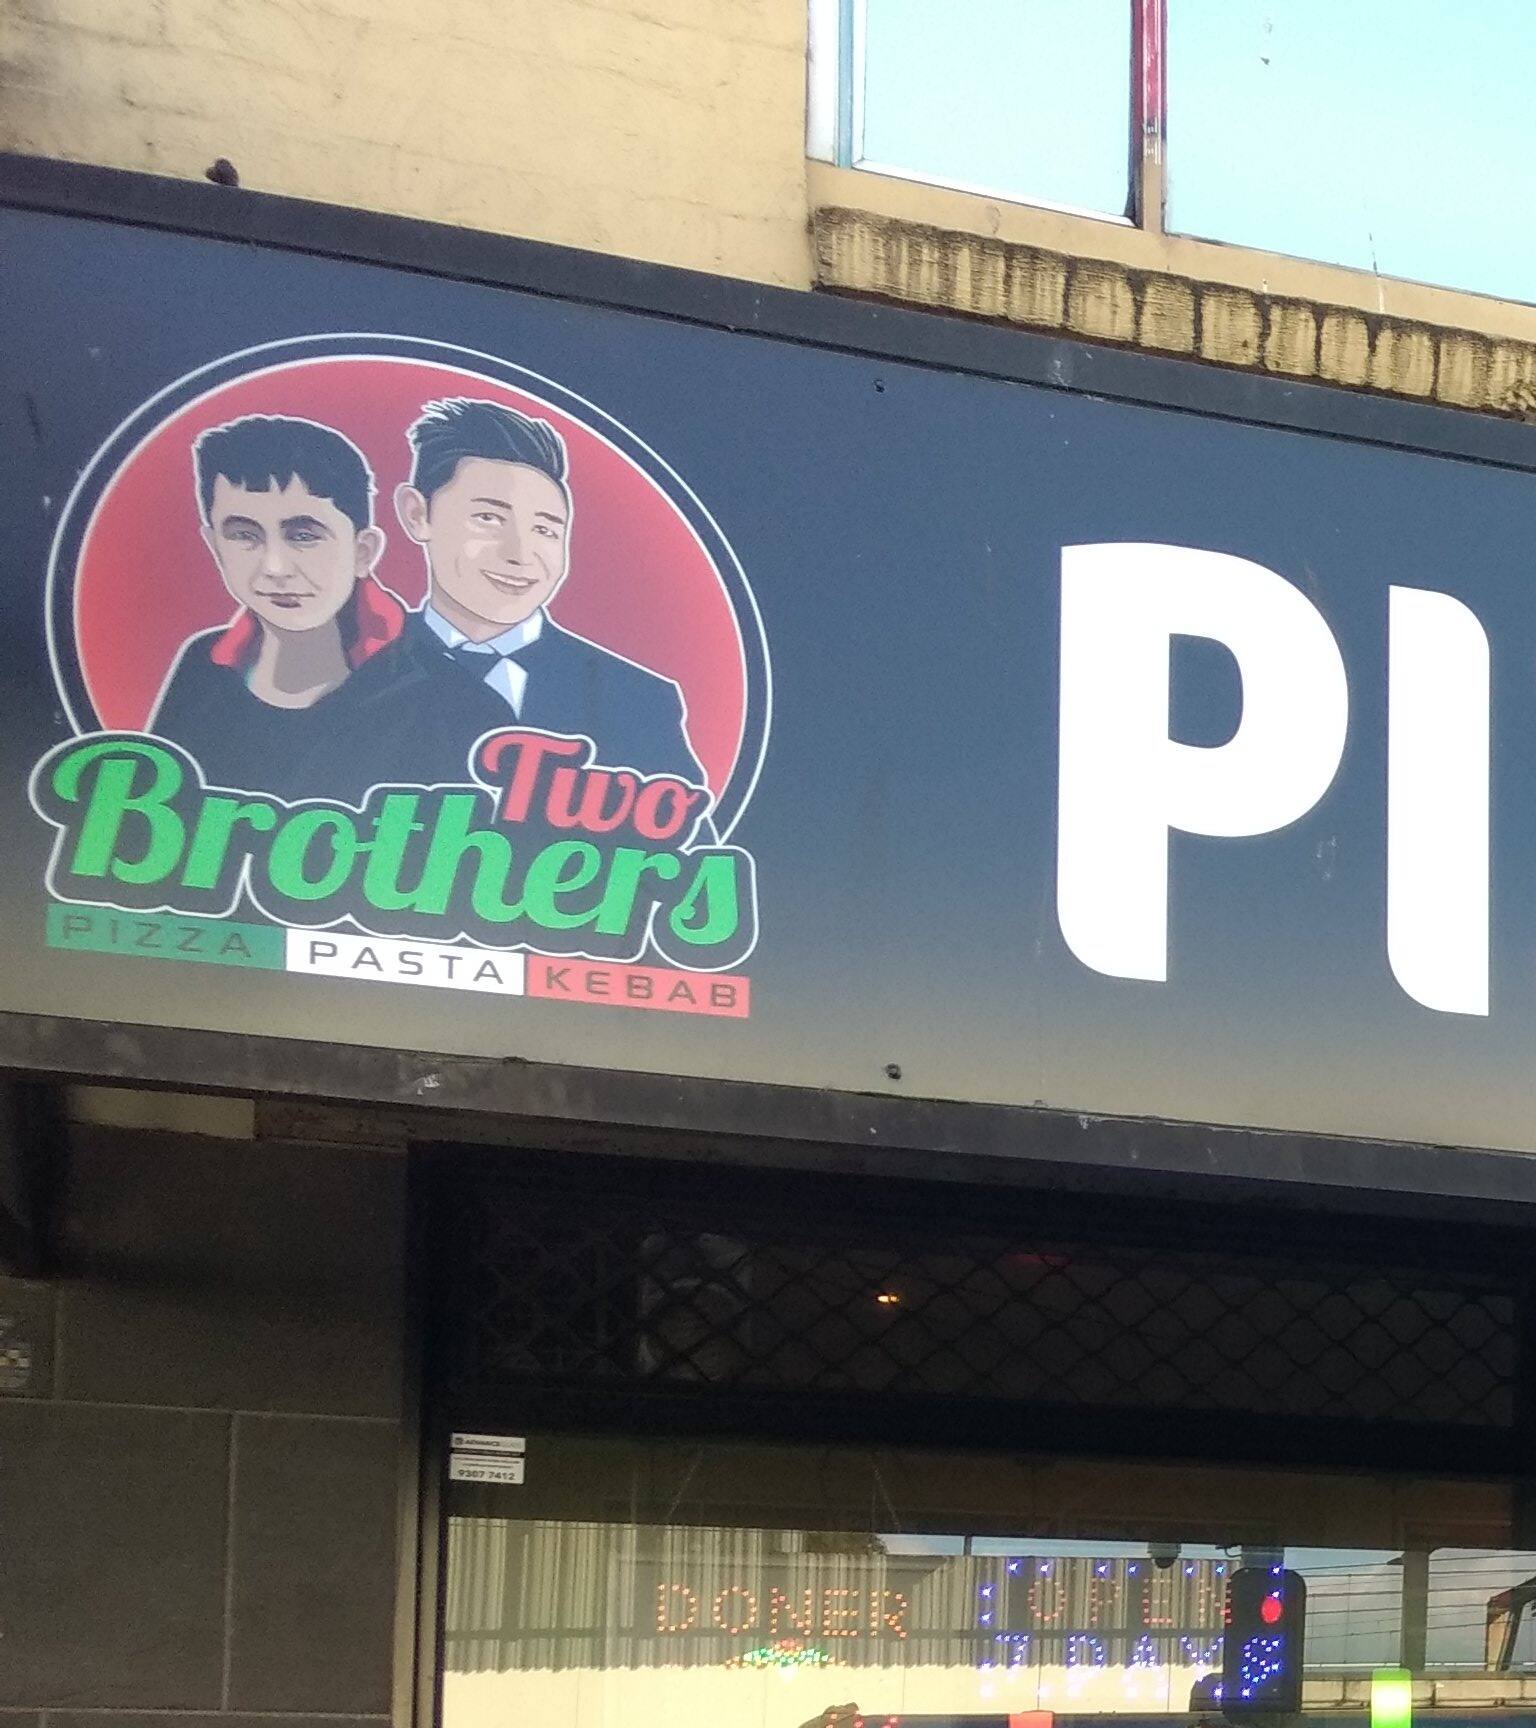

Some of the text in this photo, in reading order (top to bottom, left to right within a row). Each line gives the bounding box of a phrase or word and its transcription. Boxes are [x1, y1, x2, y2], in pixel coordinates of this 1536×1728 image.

[482, 734, 706, 842] Two
[53, 741, 740, 946] Brothers
[62, 916, 738, 1009] PIZZA PASTA KEBAB
[656, 1584, 908, 1638] DONER
